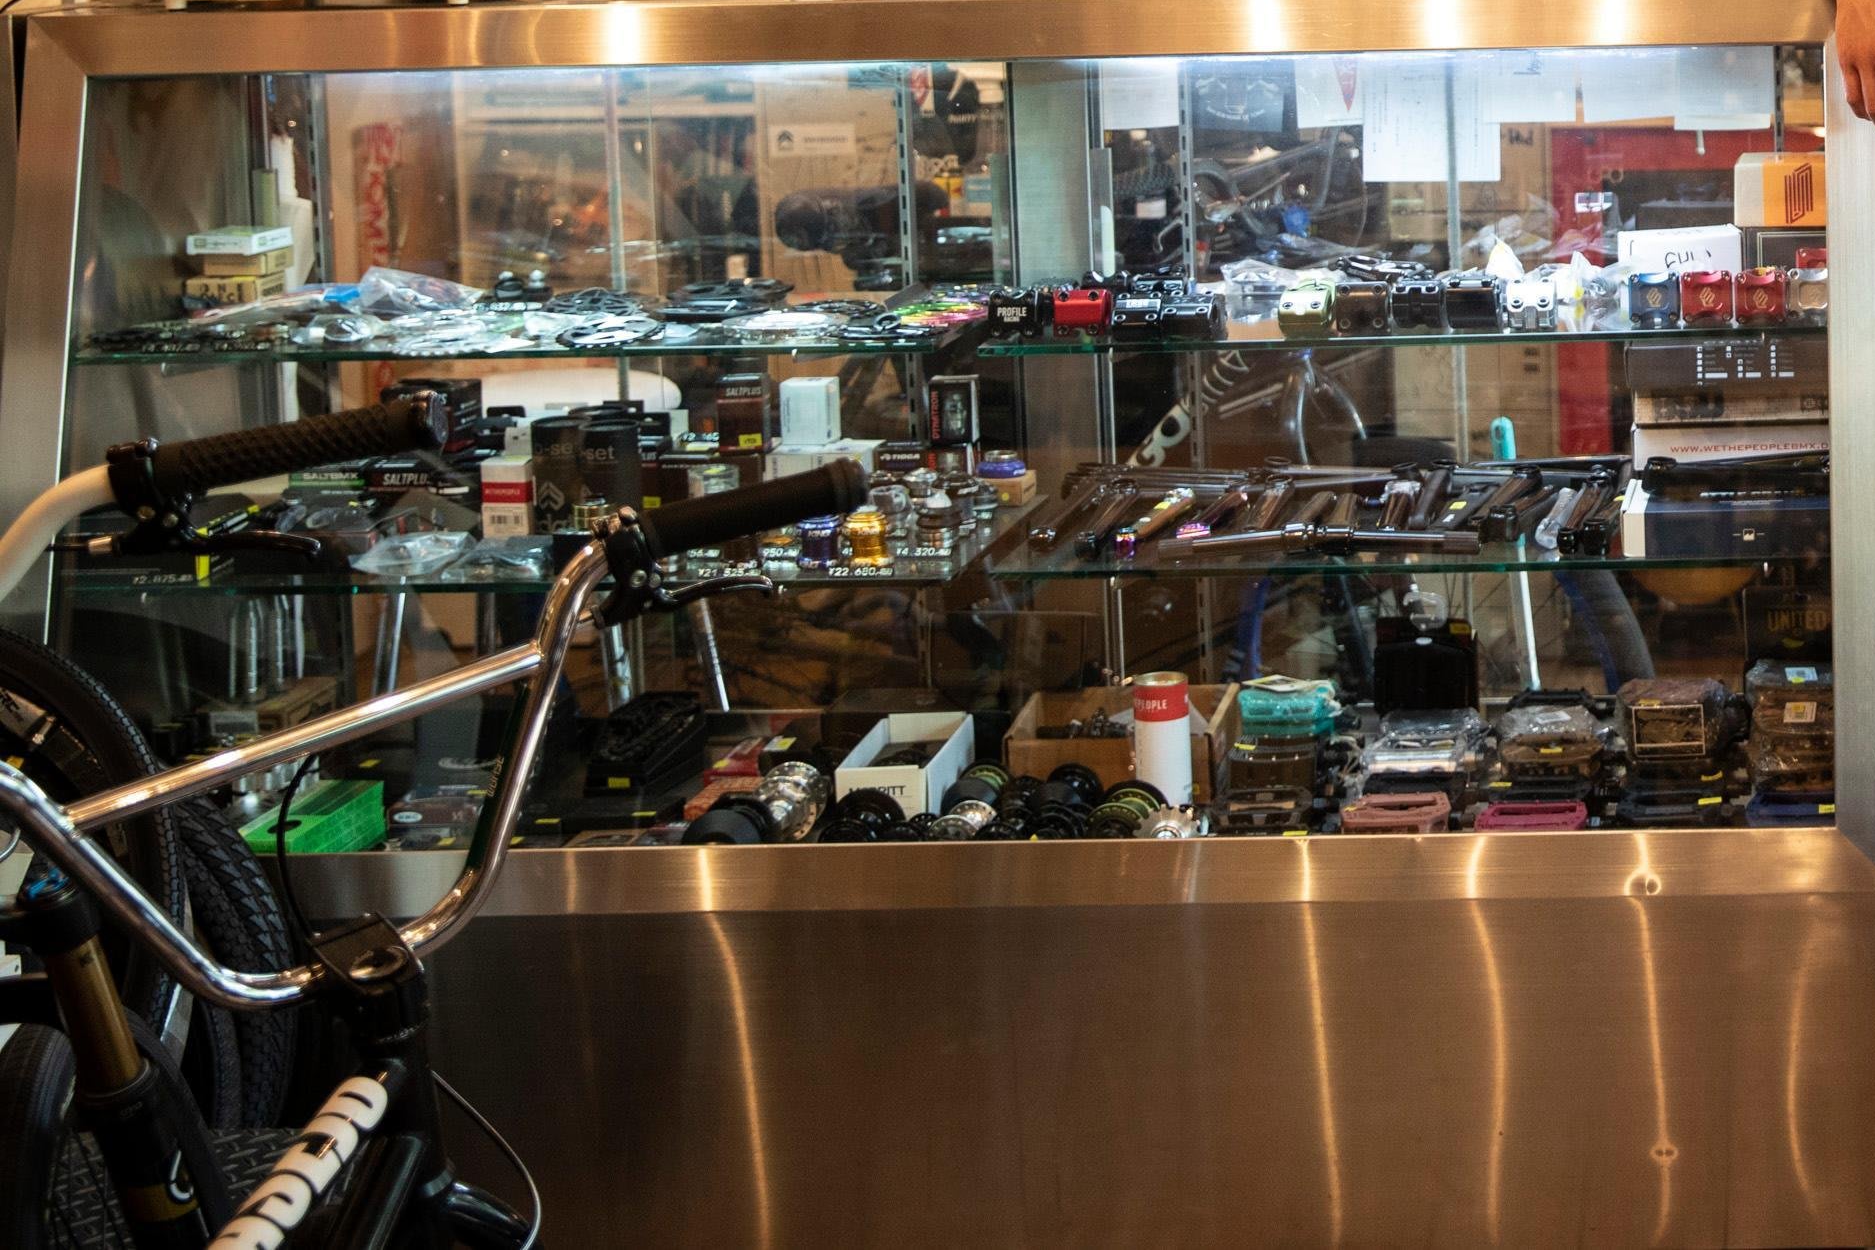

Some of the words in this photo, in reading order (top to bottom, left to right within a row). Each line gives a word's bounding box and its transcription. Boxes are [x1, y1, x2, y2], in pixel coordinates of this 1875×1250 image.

[996, 305, 1027, 317] PROFILE
[725, 386, 762, 397] SALTPLUS
[891, 453, 921, 461] TIOGA
[303, 471, 358, 481] SALTBMX
